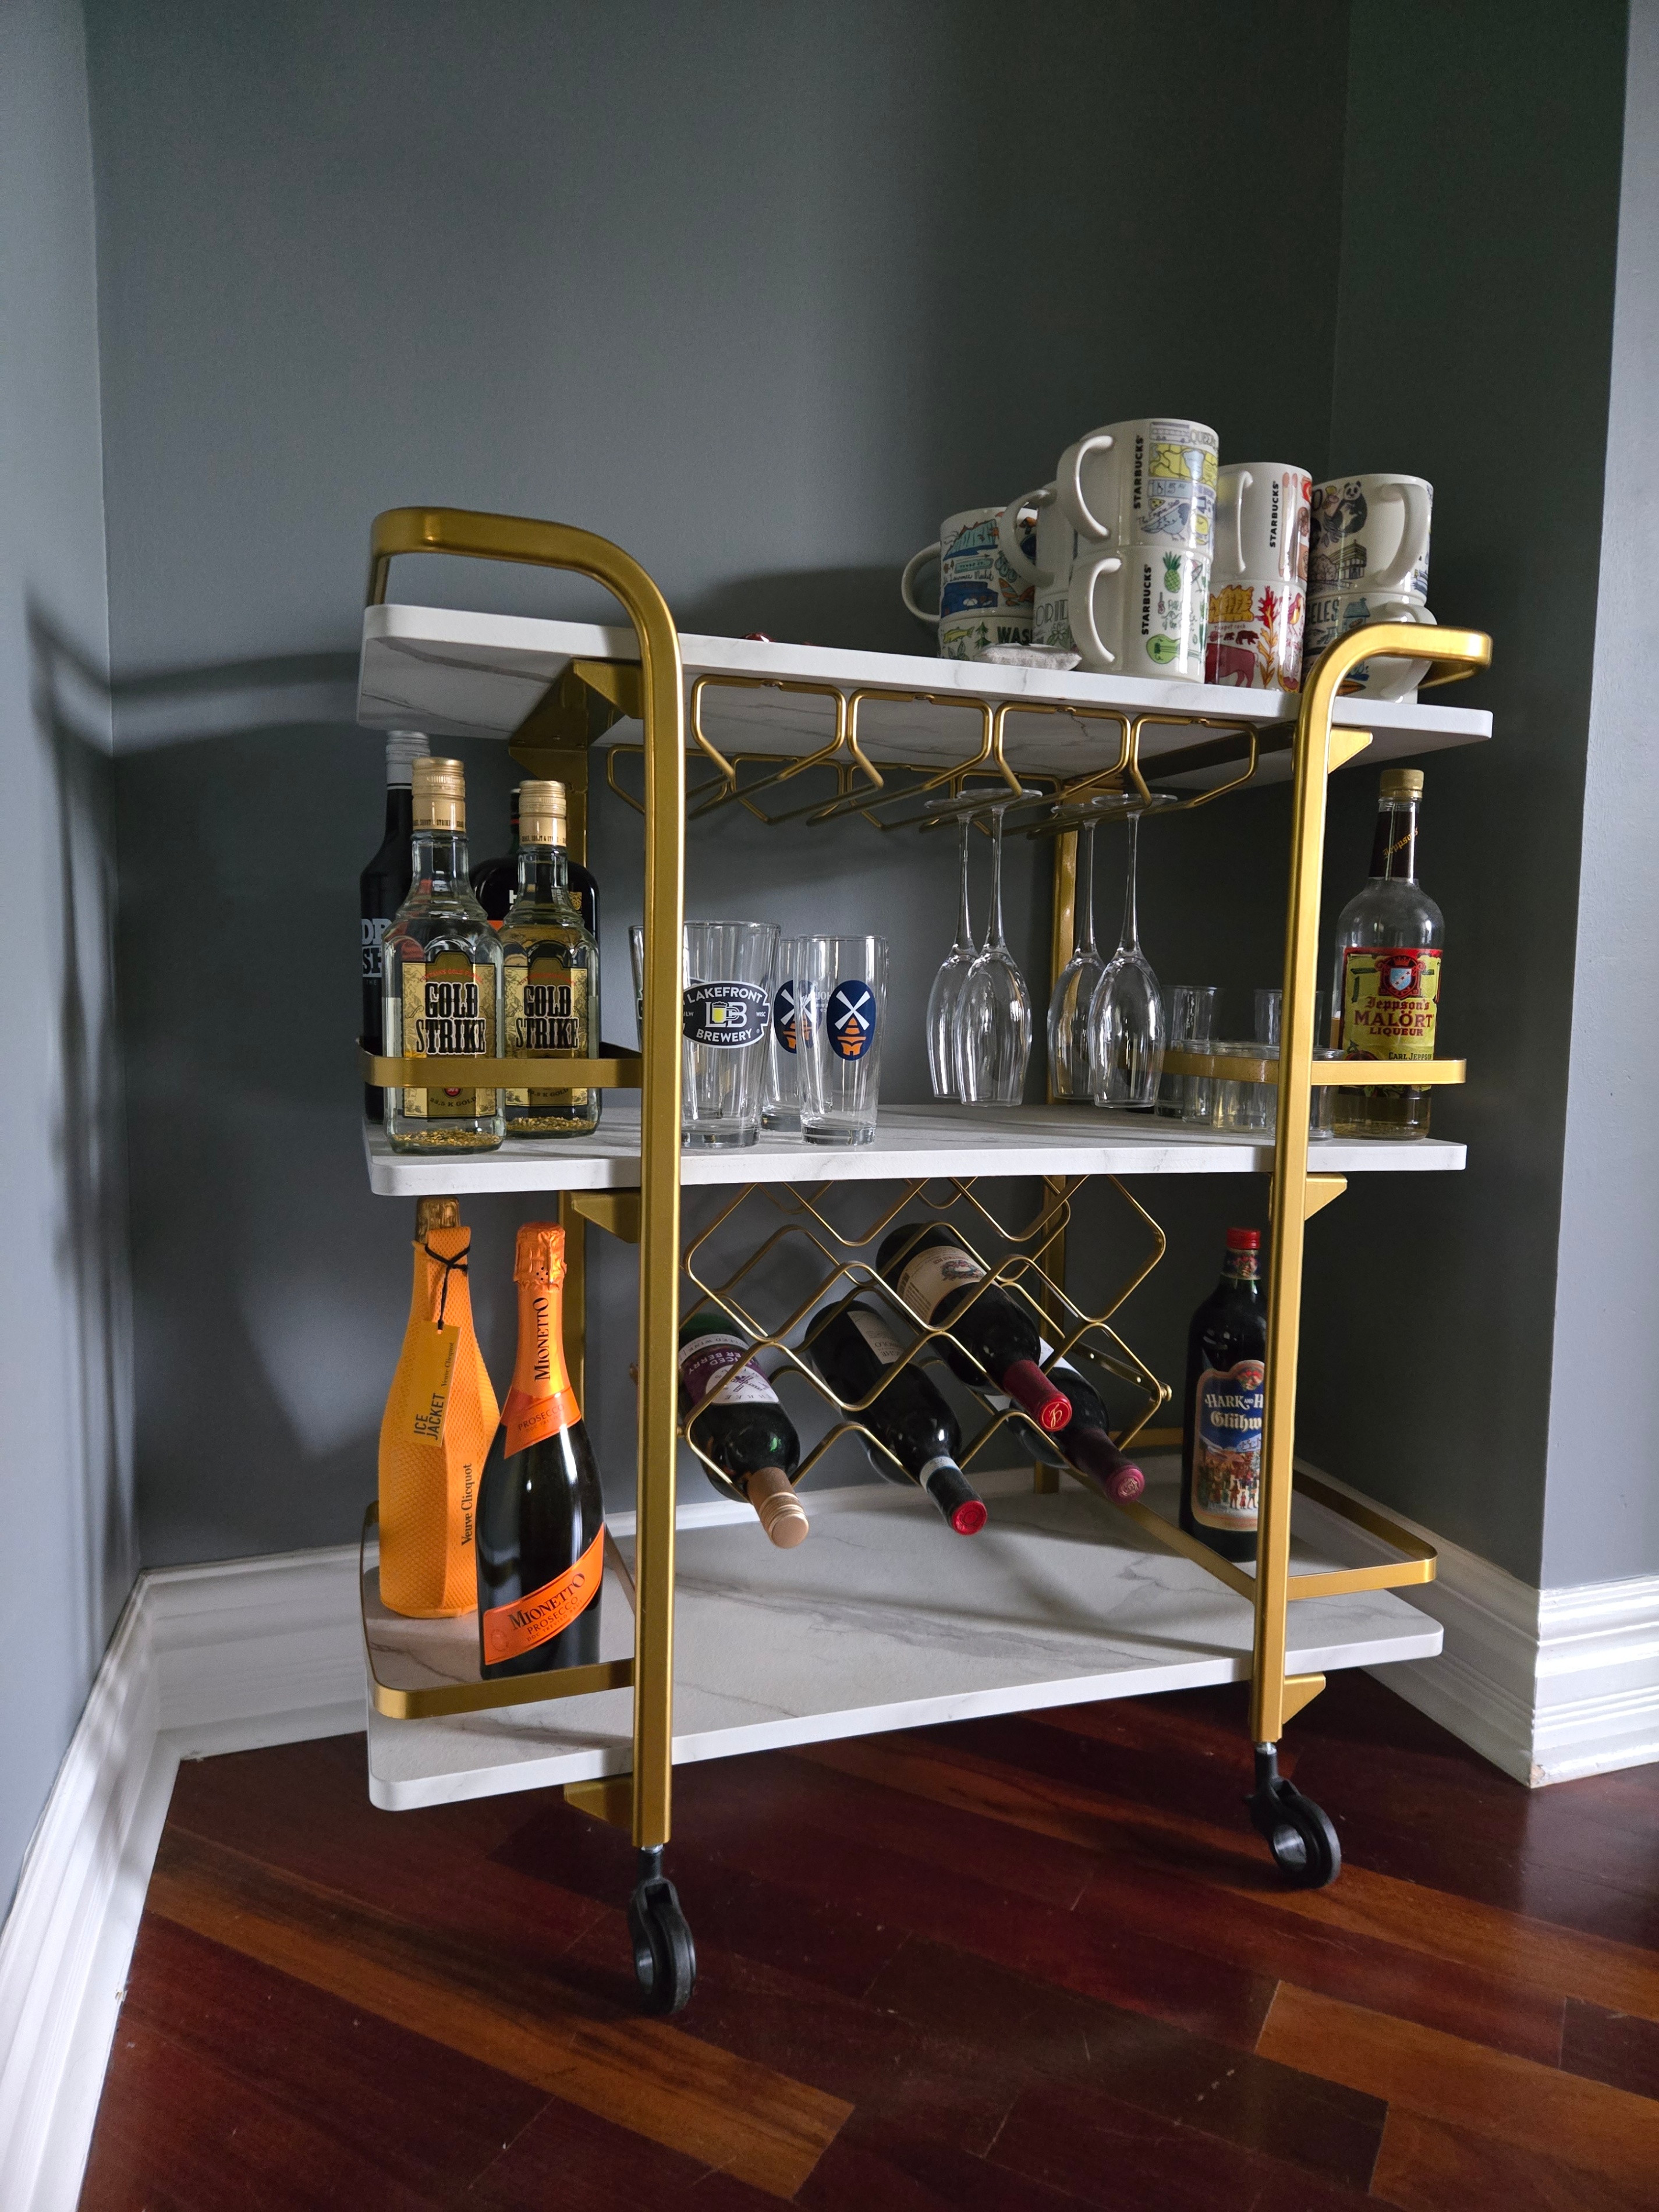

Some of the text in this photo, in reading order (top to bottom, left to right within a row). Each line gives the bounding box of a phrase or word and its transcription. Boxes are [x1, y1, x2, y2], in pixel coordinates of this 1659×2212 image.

[1133, 437, 1144, 509] STARBUCKS
[1270, 483, 1279, 548] STARBUCKS
[1142, 566, 1151, 635] STARBUCKS
[1310, 599, 1339, 625] ELES
[424, 982, 478, 1019] GOLD
[523, 984, 572, 1018] GOLD
[687, 987, 762, 1004] LAKEFRONT
[1365, 996, 1430, 1012] Jeppson's
[1354, 1010, 1433, 1028] MALÖRT
[1369, 1027, 1424, 1037] LIQUEUR
[416, 1018, 487, 1055] STRIKE
[516, 1017, 579, 1050] STRIKE
[696, 1028, 753, 1043] BREWERY
[1388, 1052, 1408, 1060] CARL
[456, 1096, 476, 1107] GOLD
[550, 1088, 569, 1097] GOLD
[533, 1297, 551, 1382] MIONETTO
[441, 1342, 455, 1386] Veuve Clicquot
[688, 1352, 723, 1375] BERRY
[710, 1356, 739, 1366] ICED
[1204, 1394, 1250, 1410] HARK
[414, 1413, 428, 1434] ICE
[426, 1392, 445, 1441] JACKET
[518, 1403, 564, 1431] PROSECCO
[1210, 1410, 1262, 1433] Glühw
[461, 1462, 475, 1546] Veuve Clicquot
[507, 1573, 585, 1630] MIONETTO
[527, 1597, 578, 1635] PROSECCO
[527, 1632, 540, 1642] DOC
[543, 1615, 568, 1633] TREVISO
